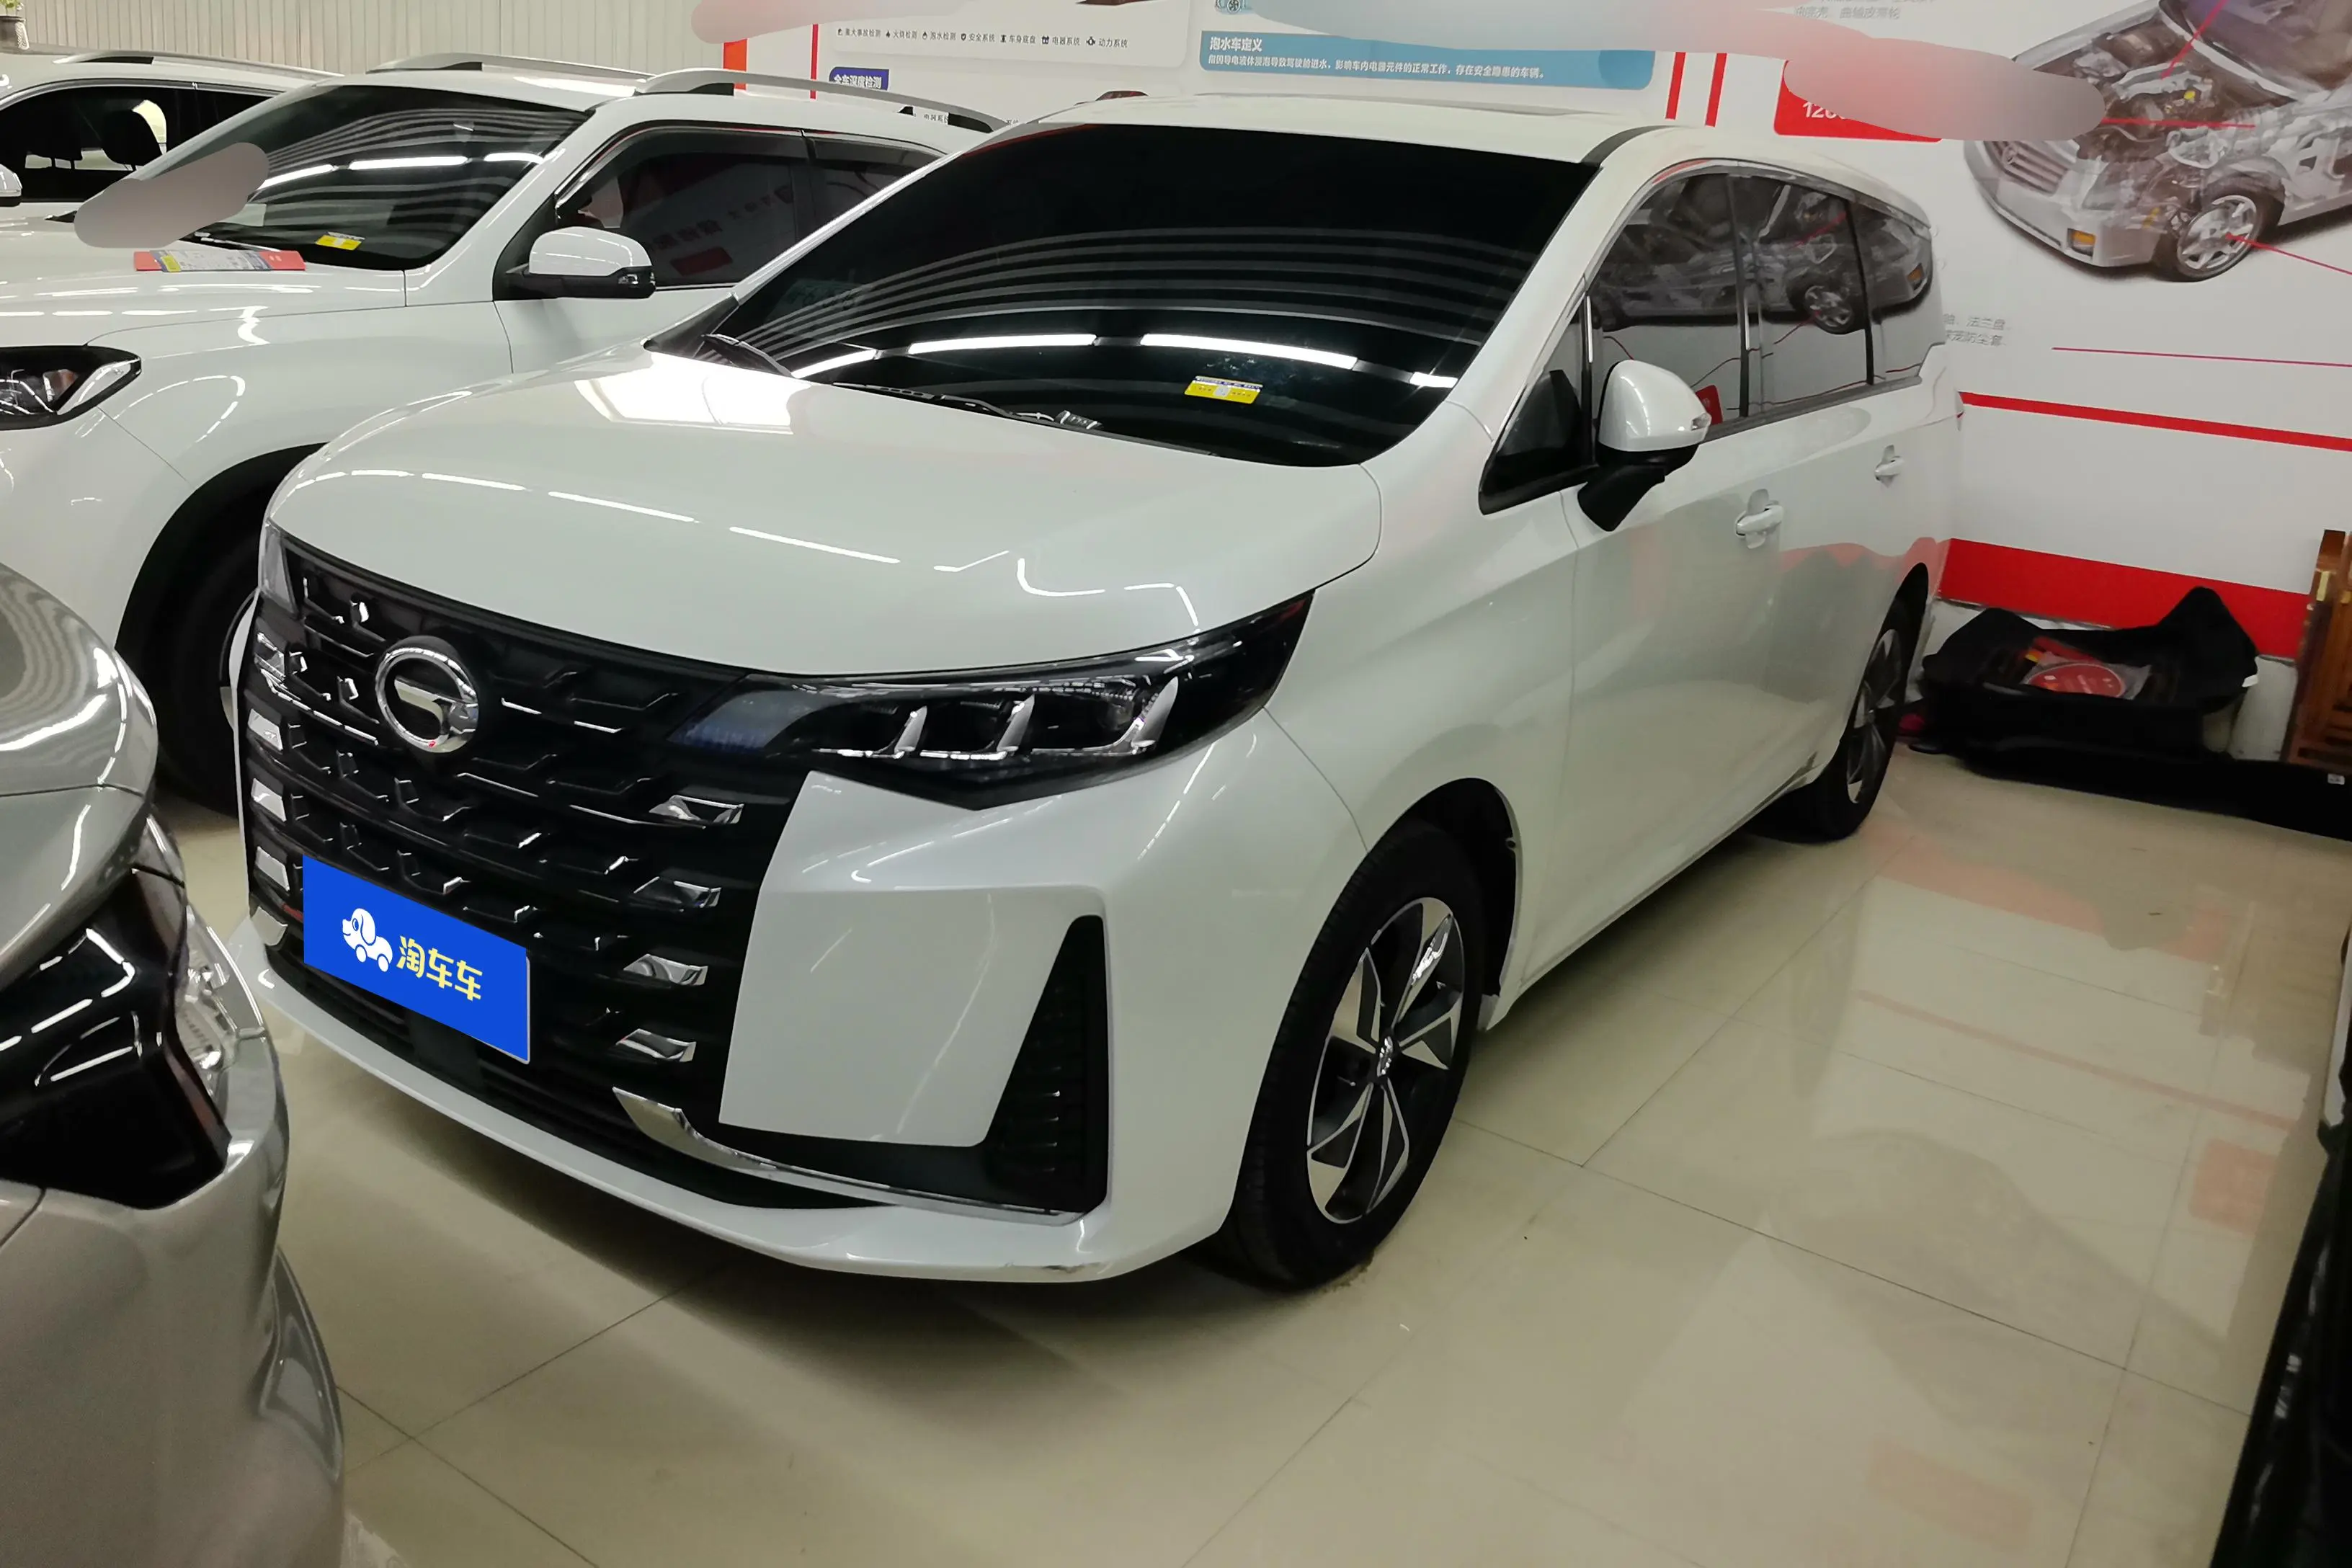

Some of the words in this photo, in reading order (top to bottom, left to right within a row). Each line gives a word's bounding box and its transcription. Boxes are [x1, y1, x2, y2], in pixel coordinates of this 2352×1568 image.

[968, 33, 995, 43] 安全系统
[1009, 35, 1036, 44] 车身底盘
[1051, 37, 1080, 46] 电器系统
[1098, 37, 1128, 48] 动力系统
[1210, 37, 1262, 52] 泡水车定义
